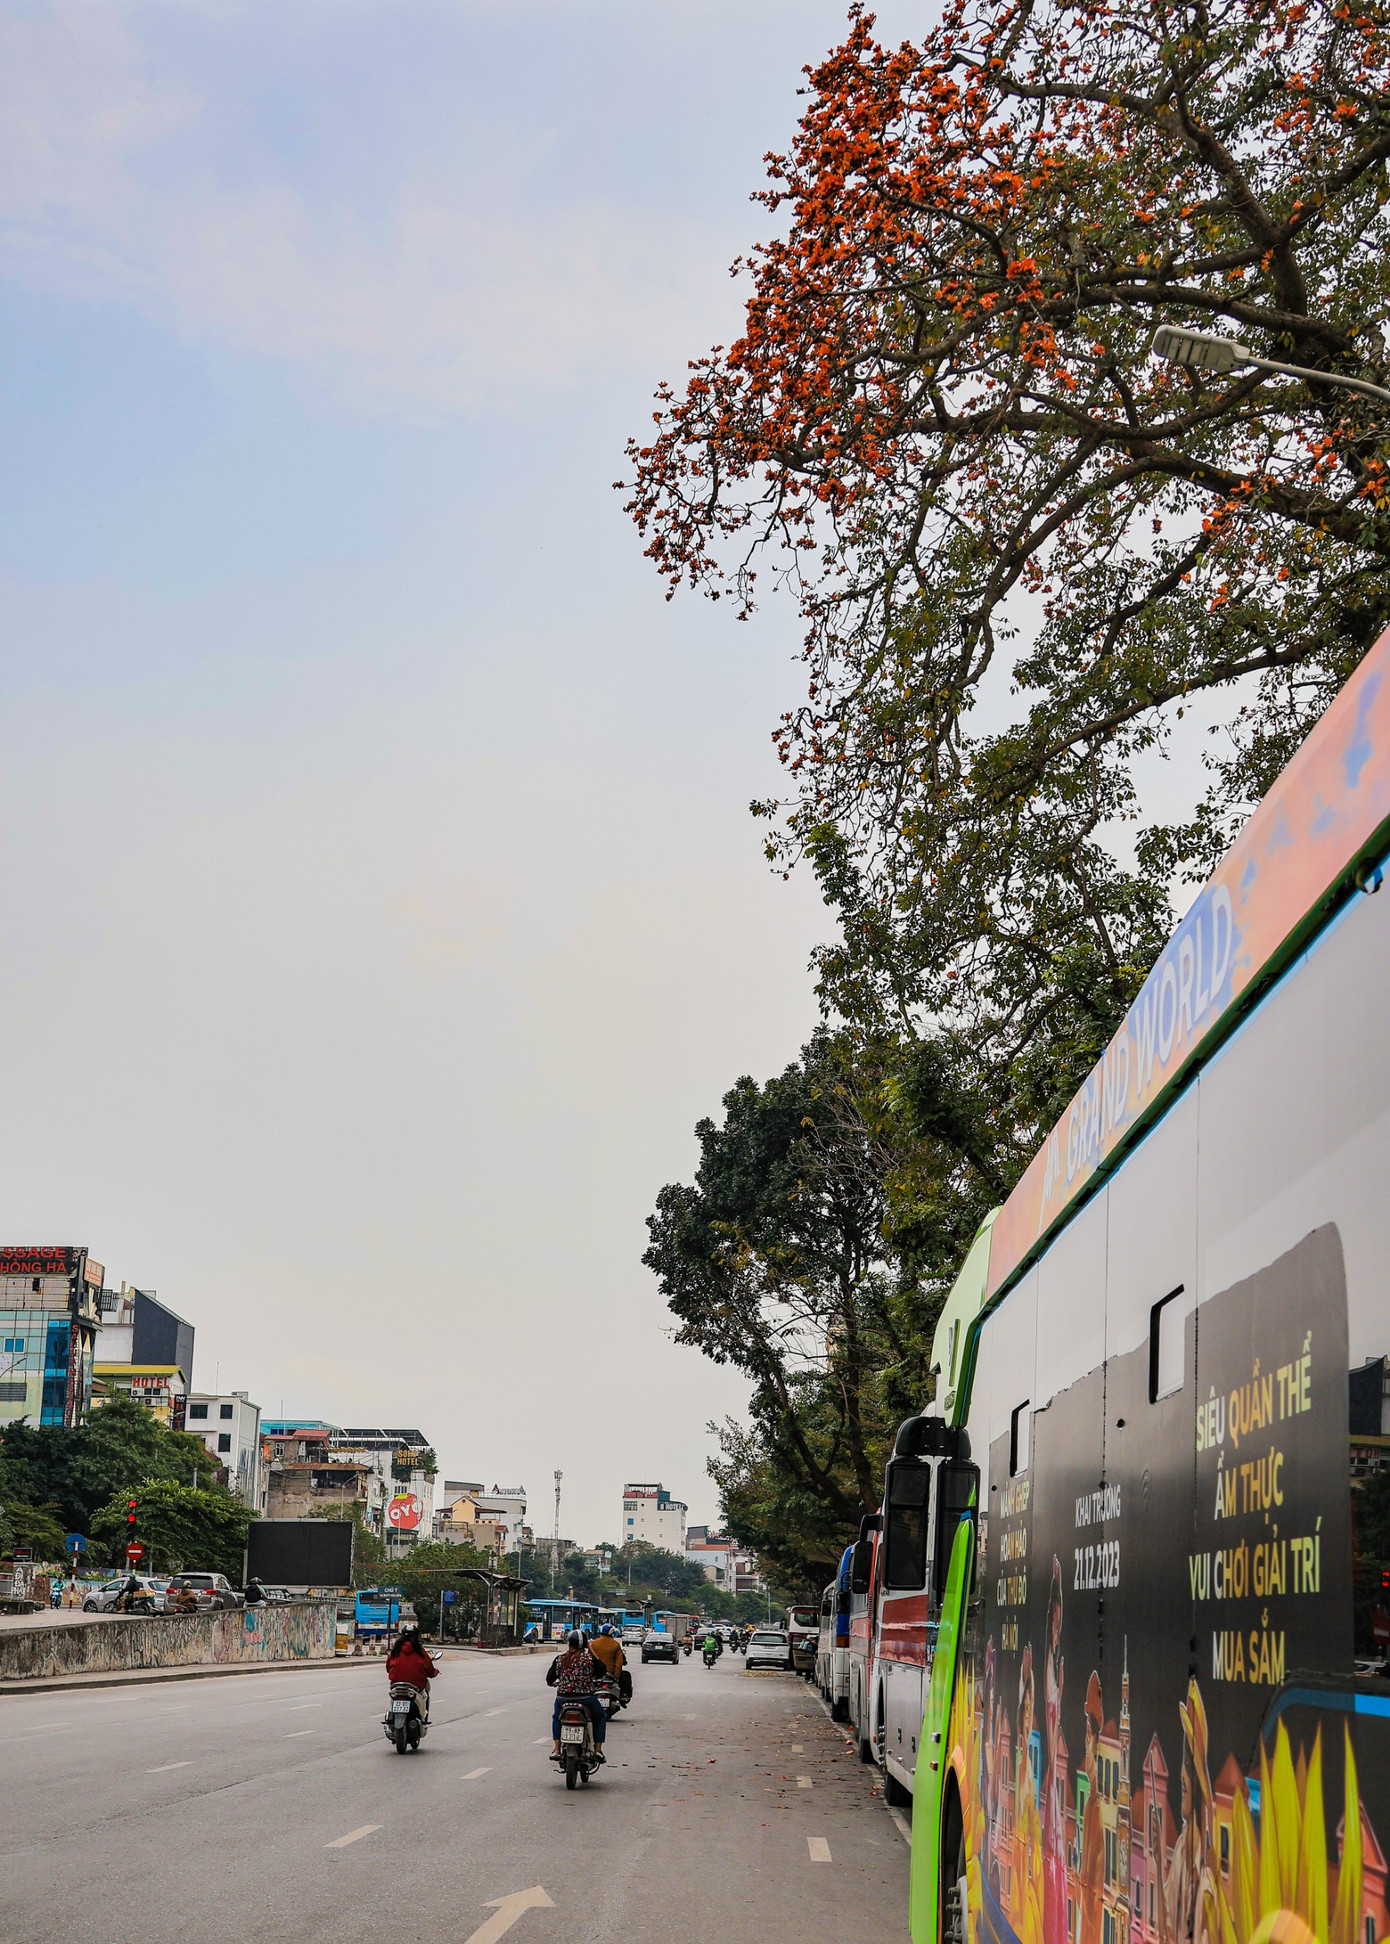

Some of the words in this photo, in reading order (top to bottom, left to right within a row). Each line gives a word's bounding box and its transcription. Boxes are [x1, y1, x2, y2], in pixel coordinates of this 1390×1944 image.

[1067, 1031, 1130, 1182] GRAND
[1136, 884, 1233, 1095] WORLD
[0, 1247, 66, 1258] SSAGE
[46, 1259, 67, 1273] HÀ
[132, 1377, 169, 1388] HOTEL
[1196, 1386, 1225, 1452] SIÊU
[1229, 1357, 1273, 1450] QUẦN
[1277, 1329, 1312, 1421] THỂ
[1214, 1450, 1237, 1521] ẨM
[1241, 1446, 1284, 1525] THỰC
[390, 1502, 422, 1520] OYO
[1075, 1494, 1092, 1528] KHAI
[1074, 1540, 1120, 1591] 21.12.2023
[1189, 1552, 1211, 1601] VUI
[1214, 1538, 1249, 1600] CHƠI
[1253, 1523, 1287, 1597] GIẢI
[1290, 1515, 1322, 1595] TRÍ
[997, 1569, 1006, 1607] CỦA
[1213, 1630, 1246, 1683] MUA
